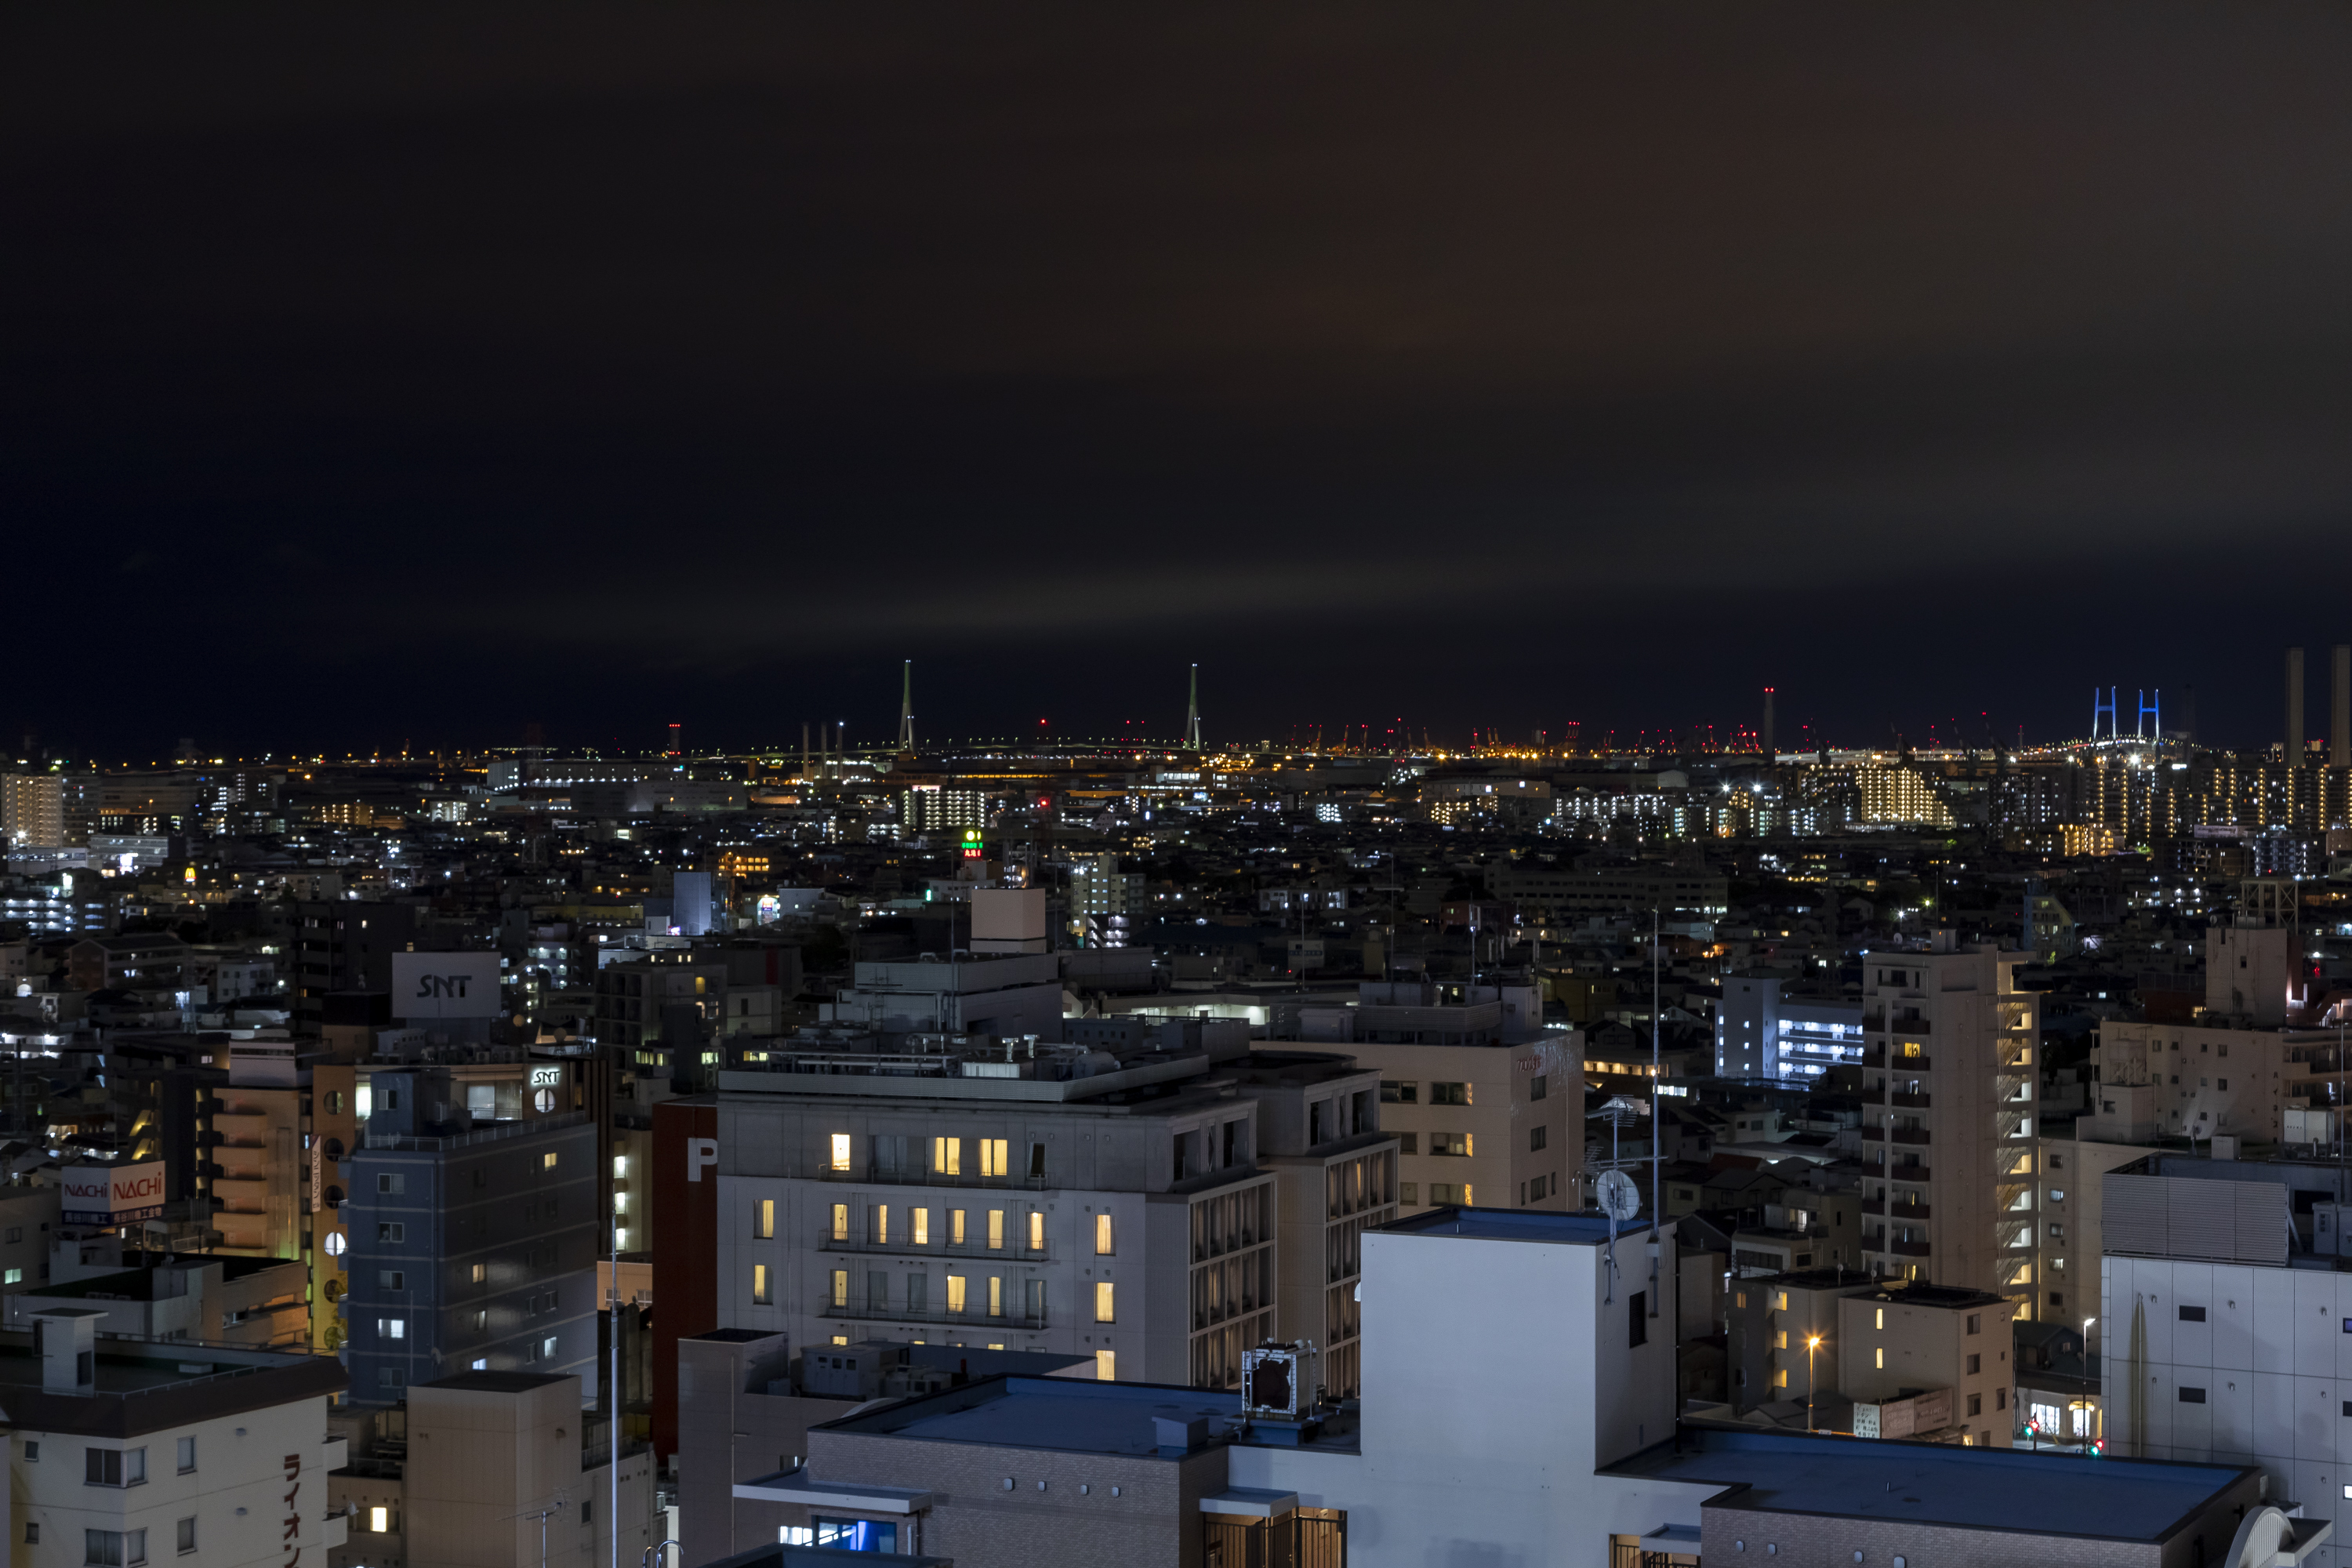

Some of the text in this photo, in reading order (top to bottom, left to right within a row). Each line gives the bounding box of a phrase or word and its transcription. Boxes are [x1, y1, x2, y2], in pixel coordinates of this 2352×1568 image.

[417, 975, 472, 998] SNT
[534, 1071, 560, 1083] SNT
[688, 1138, 717, 1181] P
